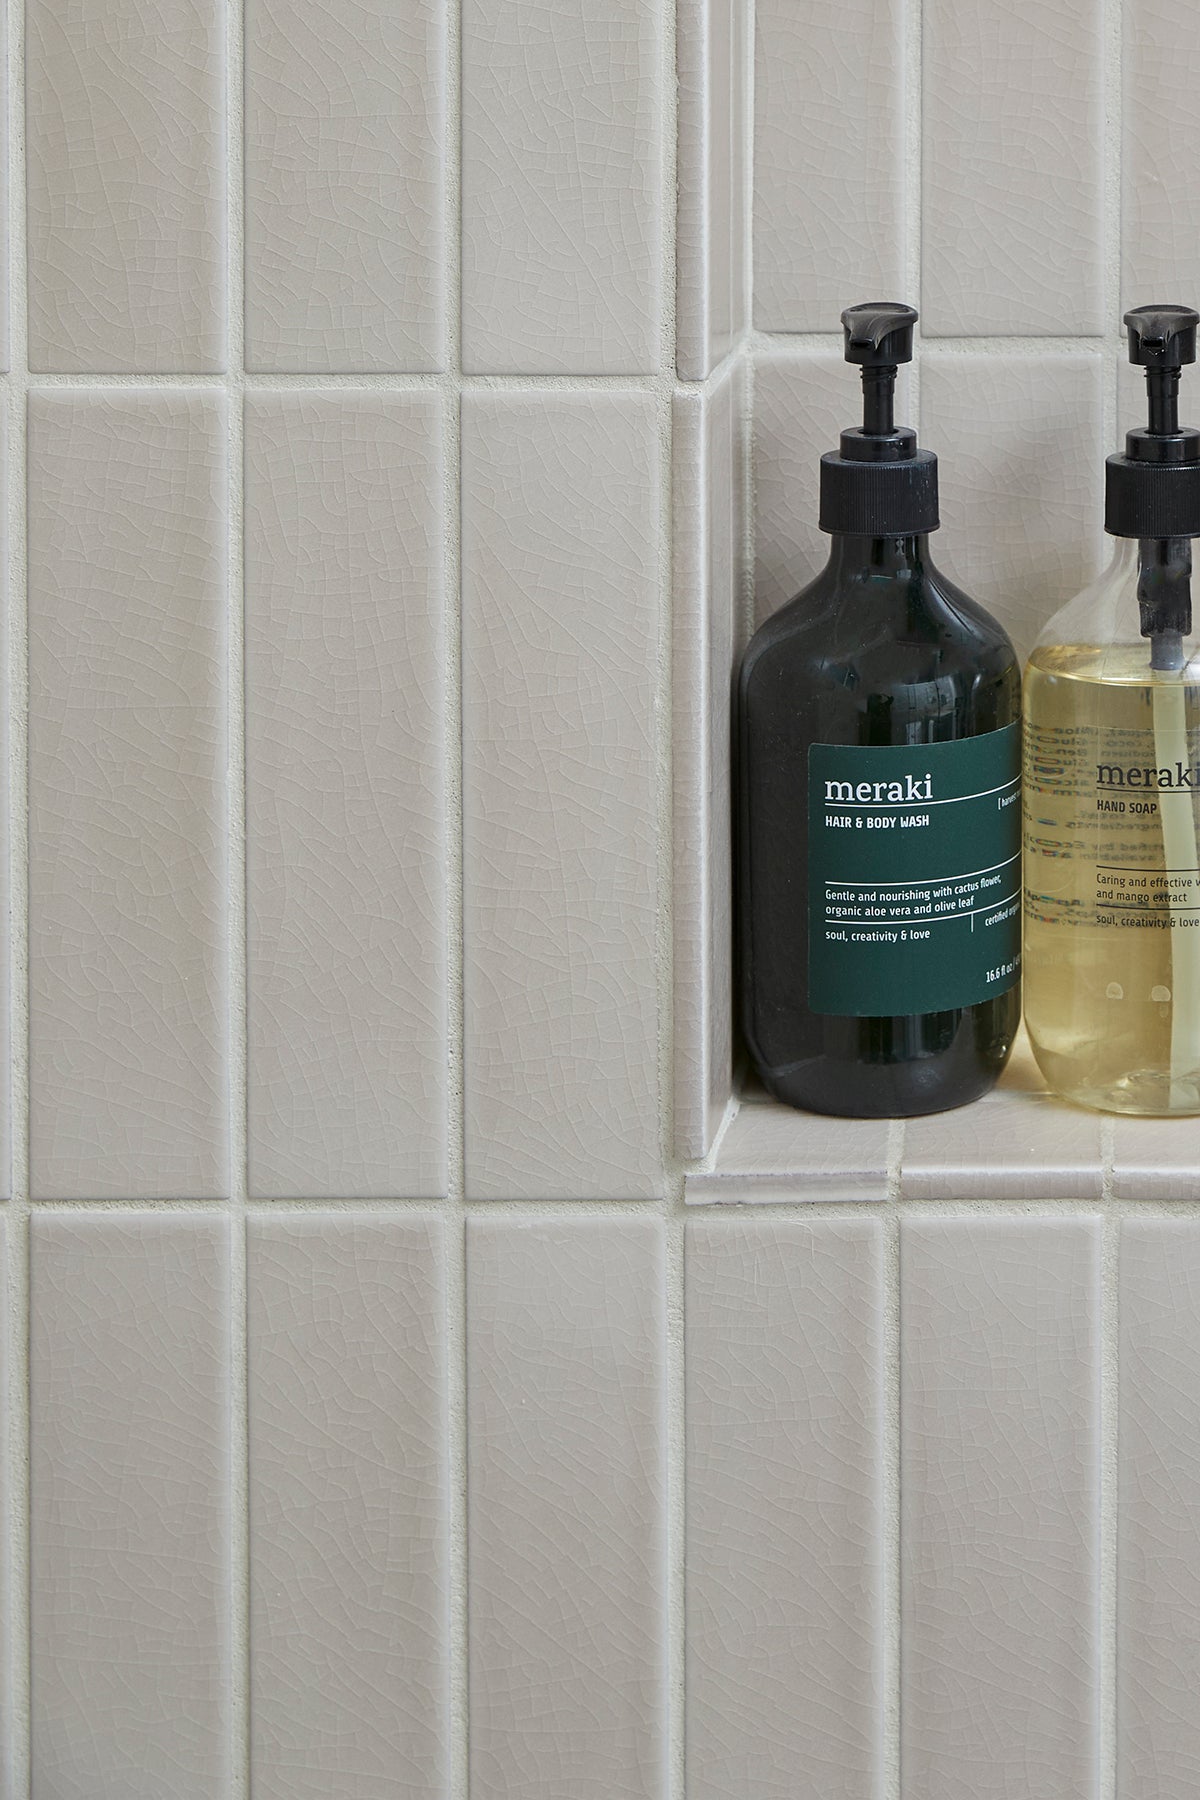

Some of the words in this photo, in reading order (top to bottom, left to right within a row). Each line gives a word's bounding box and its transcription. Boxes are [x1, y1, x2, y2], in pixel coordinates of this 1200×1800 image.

[824, 773, 933, 802] meraki
[1097, 800, 1126, 813] HAND
[1129, 802, 1157, 815] SOAP
[825, 815, 852, 828] HAIR
[855, 816, 863, 828] &
[866, 816, 897, 829] BODY
[900, 814, 930, 828] WASH
[825, 889, 855, 901] Gentle
[858, 889, 876, 902] and
[879, 888, 931, 901] nourishing
[933, 886, 953, 898] with
[954, 881, 979, 894] cactus
[980, 874, 1002, 889] flower,
[1096, 873, 1126, 888] Caring
[1129, 876, 1147, 888] and
[1150, 876, 1193, 888] effective
[1096, 889, 1114, 900] and
[1116, 891, 1150, 904] mango
[1152, 892, 1188, 903] extract
[825, 905, 862, 918] organic
[864, 906, 887, 917] aloe
[889, 907, 911, 916] vera
[914, 903, 932, 914] and
[934, 900, 956, 912] olive
[958, 895, 975, 909] leaf
[984, 907, 1009, 927] certified
[1096, 914, 1119, 927] soul,
[1121, 916, 1167, 929] creativity
[1169, 916, 1176, 927] &
[1179, 915, 1200, 927] love
[825, 930, 849, 942] soul,
[851, 930, 898, 943] creativity
[900, 930, 908, 941] &
[910, 929, 931, 940] love
[986, 967, 1001, 983] 16.6
